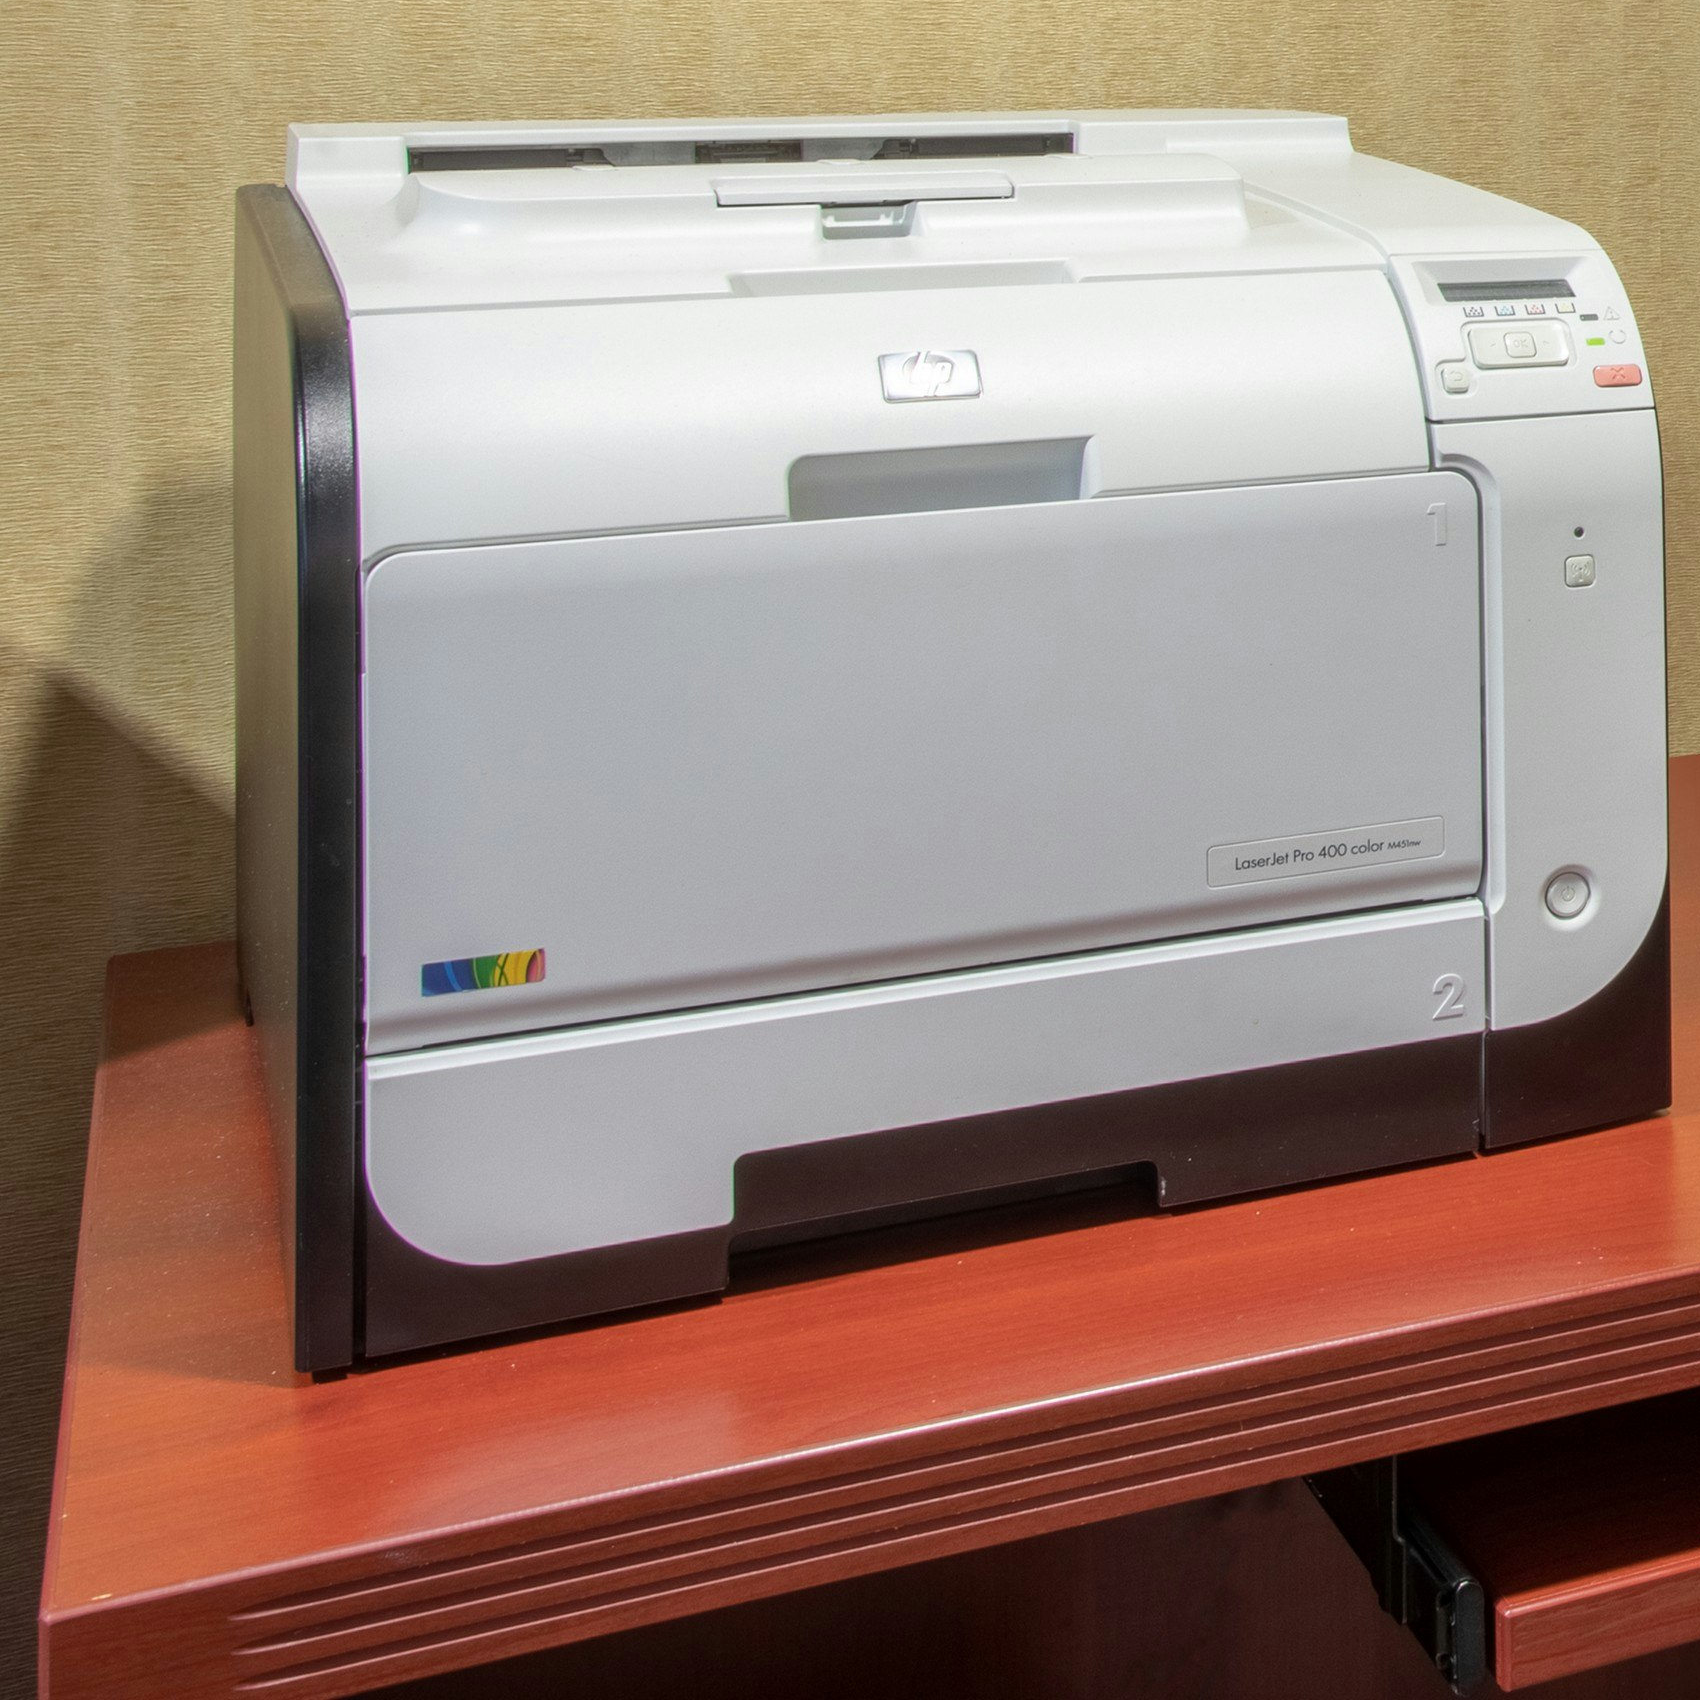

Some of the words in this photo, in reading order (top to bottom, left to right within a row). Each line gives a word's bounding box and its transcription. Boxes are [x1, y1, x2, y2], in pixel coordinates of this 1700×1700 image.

[1512, 338, 1530, 349] OK
[1426, 502, 1447, 547] 1
[1235, 852, 1289, 871] LaserJet
[1293, 849, 1315, 863] Pro
[1318, 843, 1348, 858] 400
[1351, 839, 1385, 855] color
[1432, 973, 1466, 1021] 2
